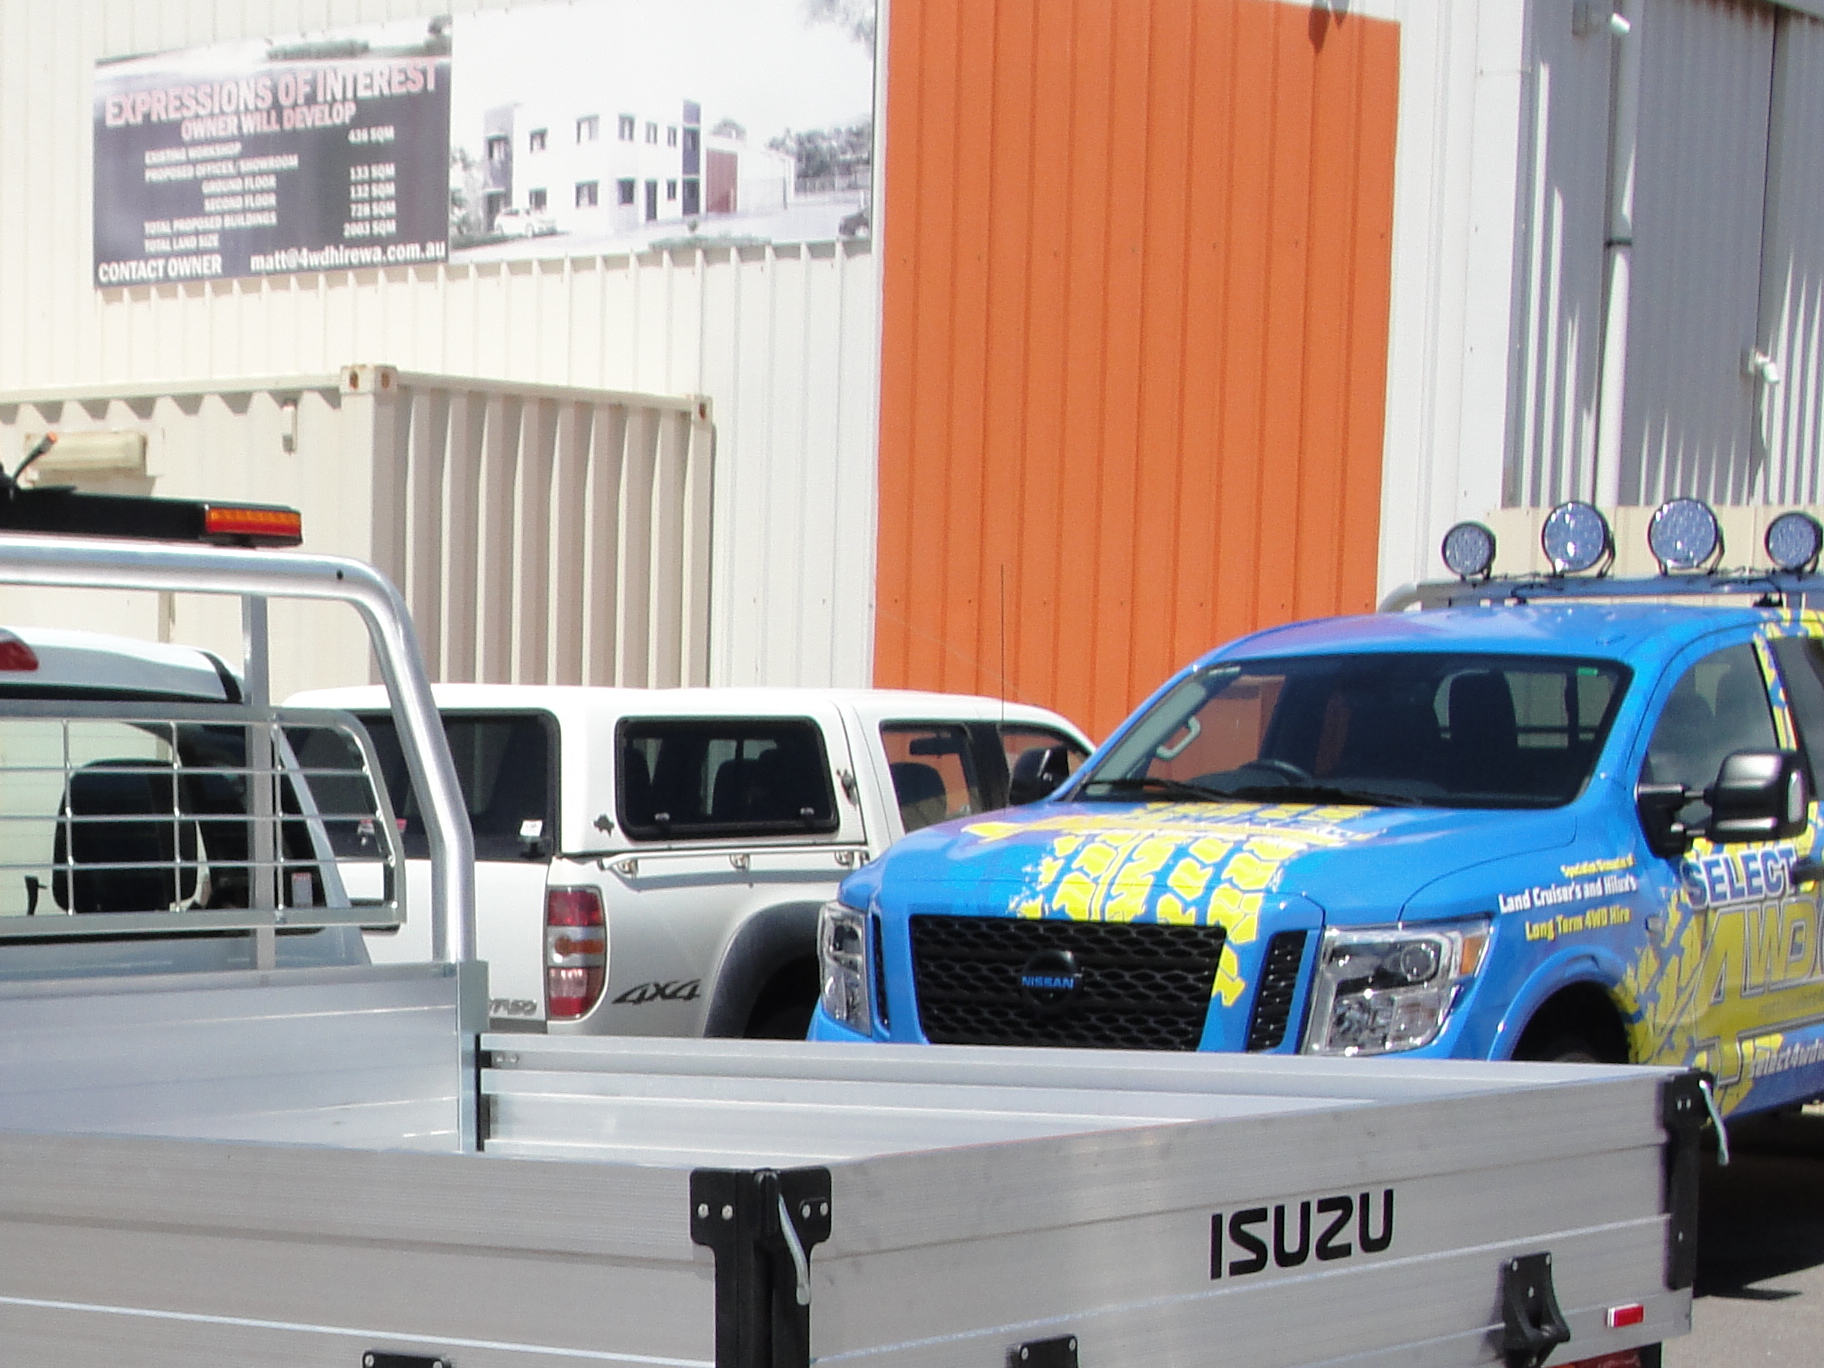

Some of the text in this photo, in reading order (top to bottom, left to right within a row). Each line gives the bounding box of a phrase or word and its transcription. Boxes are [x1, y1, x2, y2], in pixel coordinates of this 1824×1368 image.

[105, 57, 438, 127] EXPRESSIONS OF INTEREST
[181, 101, 357, 141] OWNER WILL DEVELOP
[244, 174, 277, 191] FLOOR
[371, 163, 395, 181] SQM
[244, 192, 277, 210] FLOOR
[371, 181, 395, 200] SQM
[371, 200, 396, 218] SQM
[371, 219, 396, 239] SQM
[98, 241, 446, 284] CONTACT OWNER matt@4wdhirewa.com.au
[1681, 845, 1797, 909] SELECT
[1498, 889, 1531, 914] Land
[1583, 878, 1603, 899] and
[1526, 919, 1555, 941] Long
[1555, 914, 1584, 935] Term
[1609, 904, 1632, 925] Hire
[1021, 976, 1074, 989] NISSAN
[1210, 1188, 1394, 1281] ISUZU
